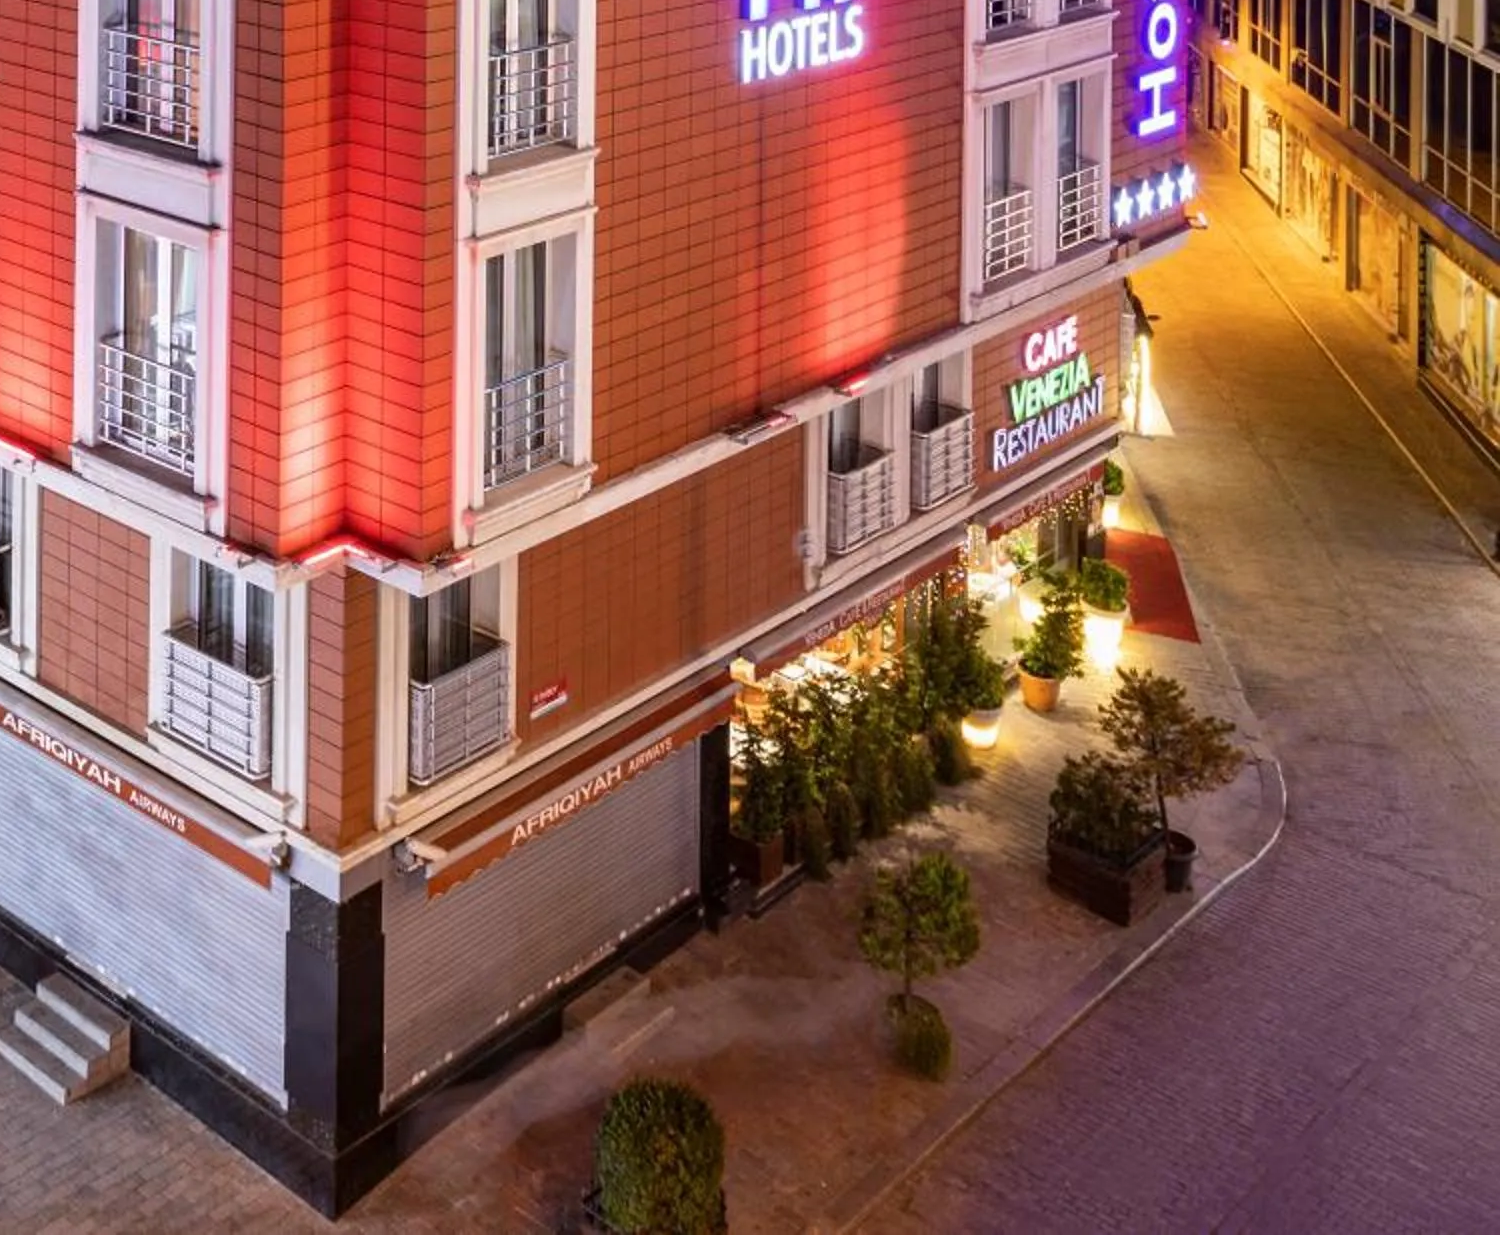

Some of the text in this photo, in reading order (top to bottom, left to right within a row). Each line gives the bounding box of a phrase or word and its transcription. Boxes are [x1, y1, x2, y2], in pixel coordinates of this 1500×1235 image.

[740, 5, 864, 83] HOTELS
[1024, 316, 1077, 371] CAFE
[993, 374, 1105, 472] RESTAURANT
[1010, 352, 1090, 424] VENEZIA
[2, 711, 186, 833] AFRIQIYAH AIRWAYS
[511, 736, 673, 845] AFRIQIYAH AIRWAYS
